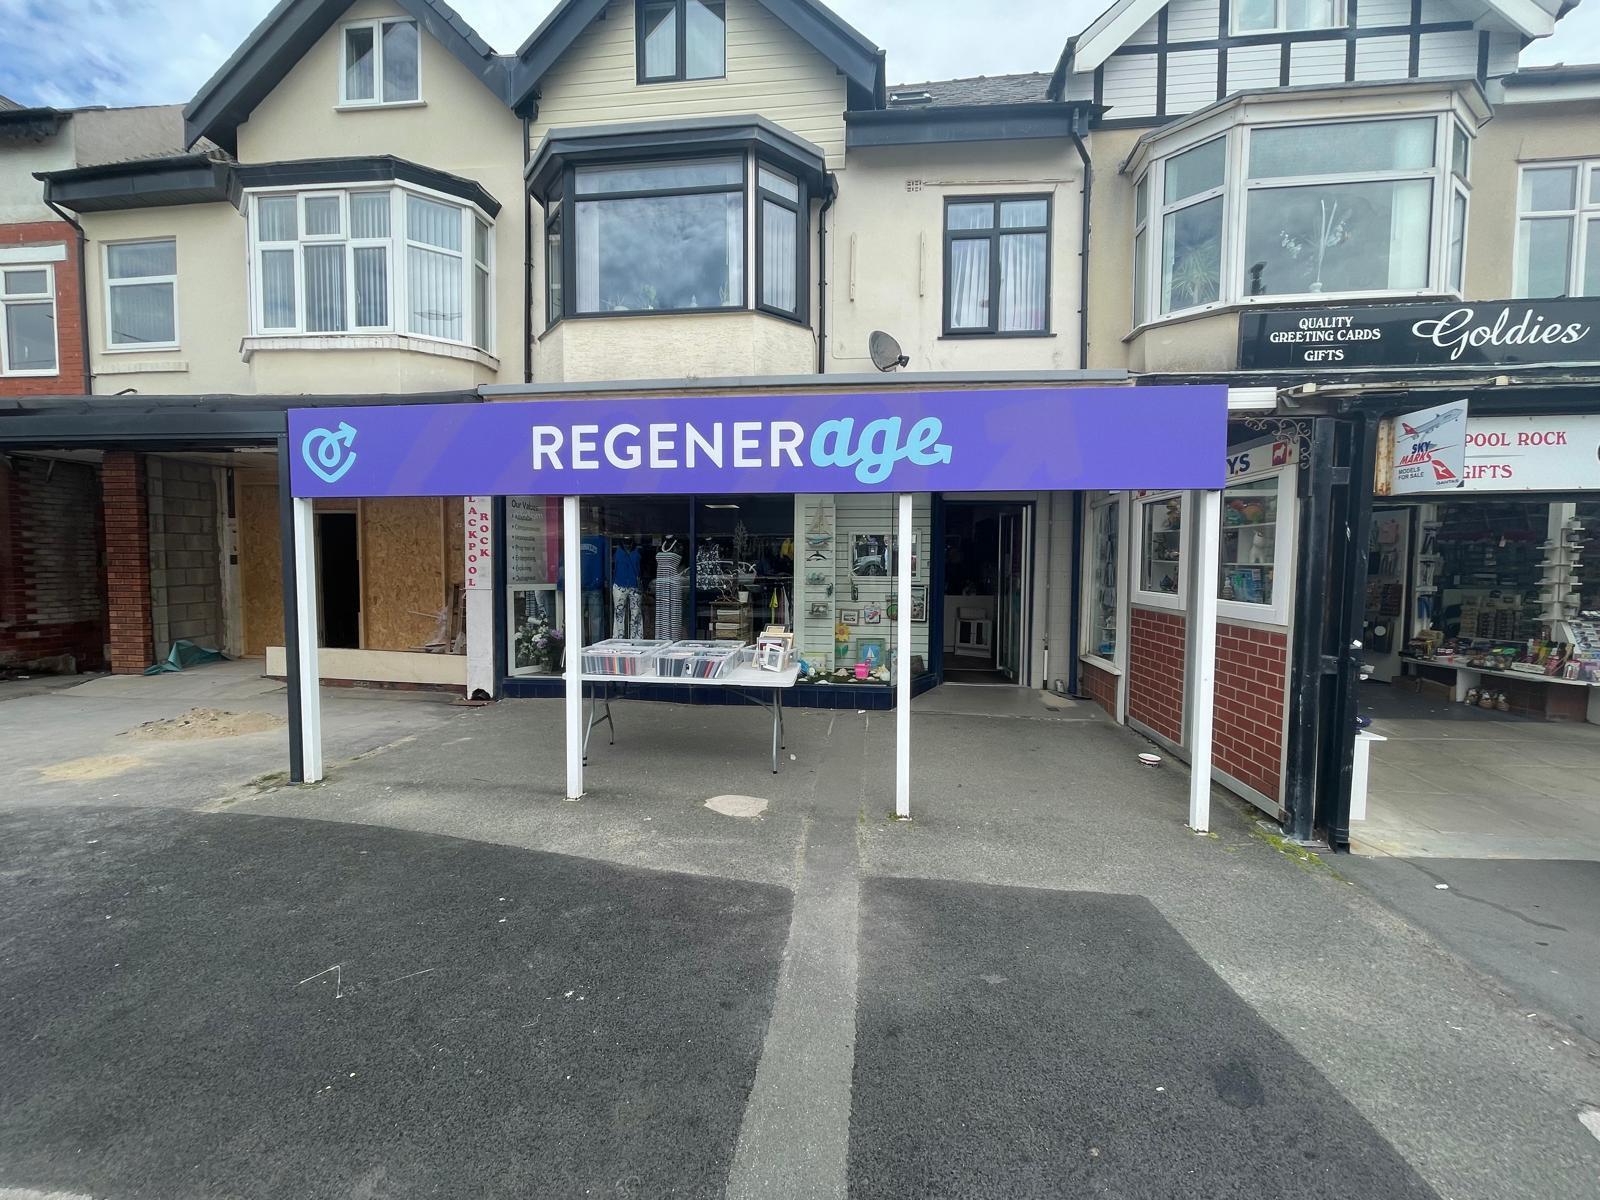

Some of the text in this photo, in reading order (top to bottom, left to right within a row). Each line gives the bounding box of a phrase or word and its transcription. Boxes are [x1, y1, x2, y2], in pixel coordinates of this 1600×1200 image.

[1299, 316, 1354, 330] QUALITY
[1270, 328, 1381, 343] GREETING CARDS
[1412, 308, 1591, 361] Goldies
[1304, 349, 1345, 361] GIFTS
[1517, 430, 1568, 447] ROCK
[532, 416, 952, 485] REGENERage
[1411, 441, 1431, 454] SKY
[1400, 452, 1432, 465] MARKS
[511, 499, 521, 509] Our
[479, 512, 490, 557] ROCK
